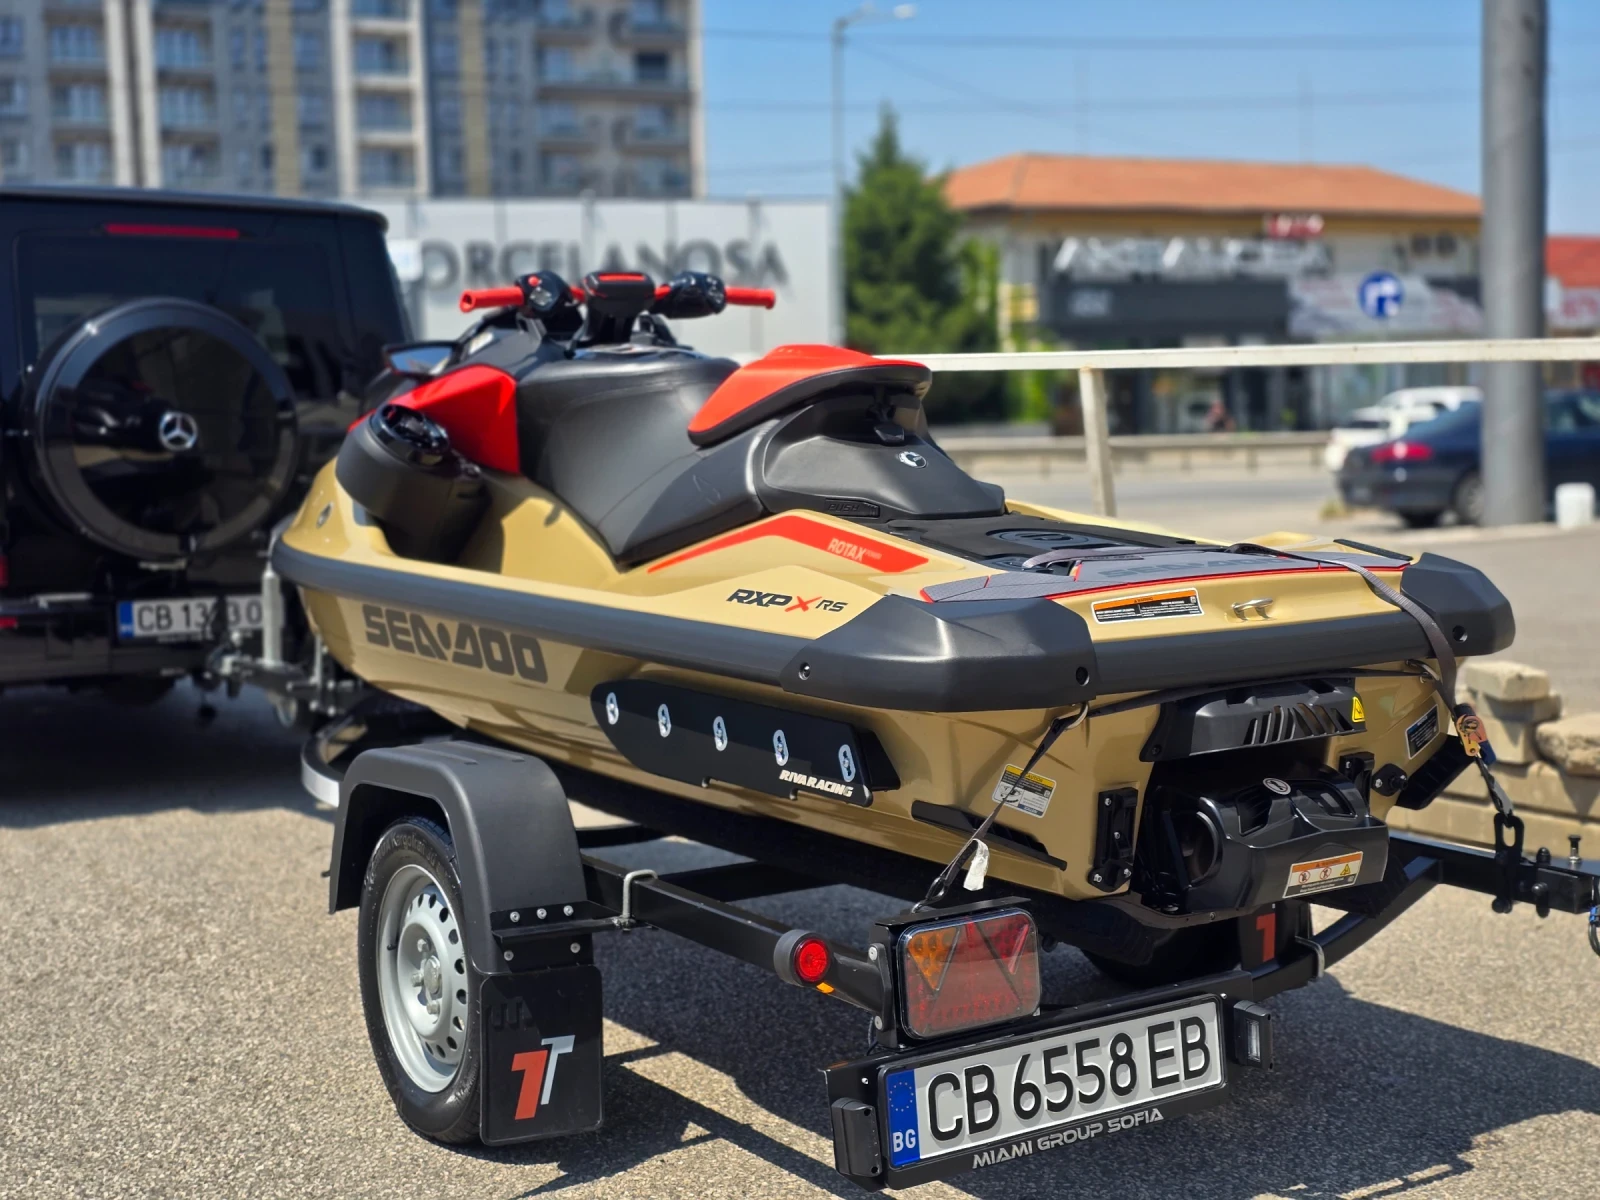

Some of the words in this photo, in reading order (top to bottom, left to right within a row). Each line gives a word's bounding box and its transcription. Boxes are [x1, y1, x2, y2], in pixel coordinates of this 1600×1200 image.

[419, 239, 792, 292] ORCELANOSA
[827, 537, 867, 562] ROTAX
[136, 604, 173, 632] CB
[815, 599, 848, 612] RS
[927, 1064, 1000, 1142] CB
[1012, 1032, 1137, 1120] 6558
[1147, 1016, 1210, 1089] EB
[893, 1129, 917, 1153] BG
[972, 1140, 1033, 1169] MIAMI
[1037, 1122, 1104, 1151] GROUP
[1107, 1108, 1164, 1134] SOFIA
